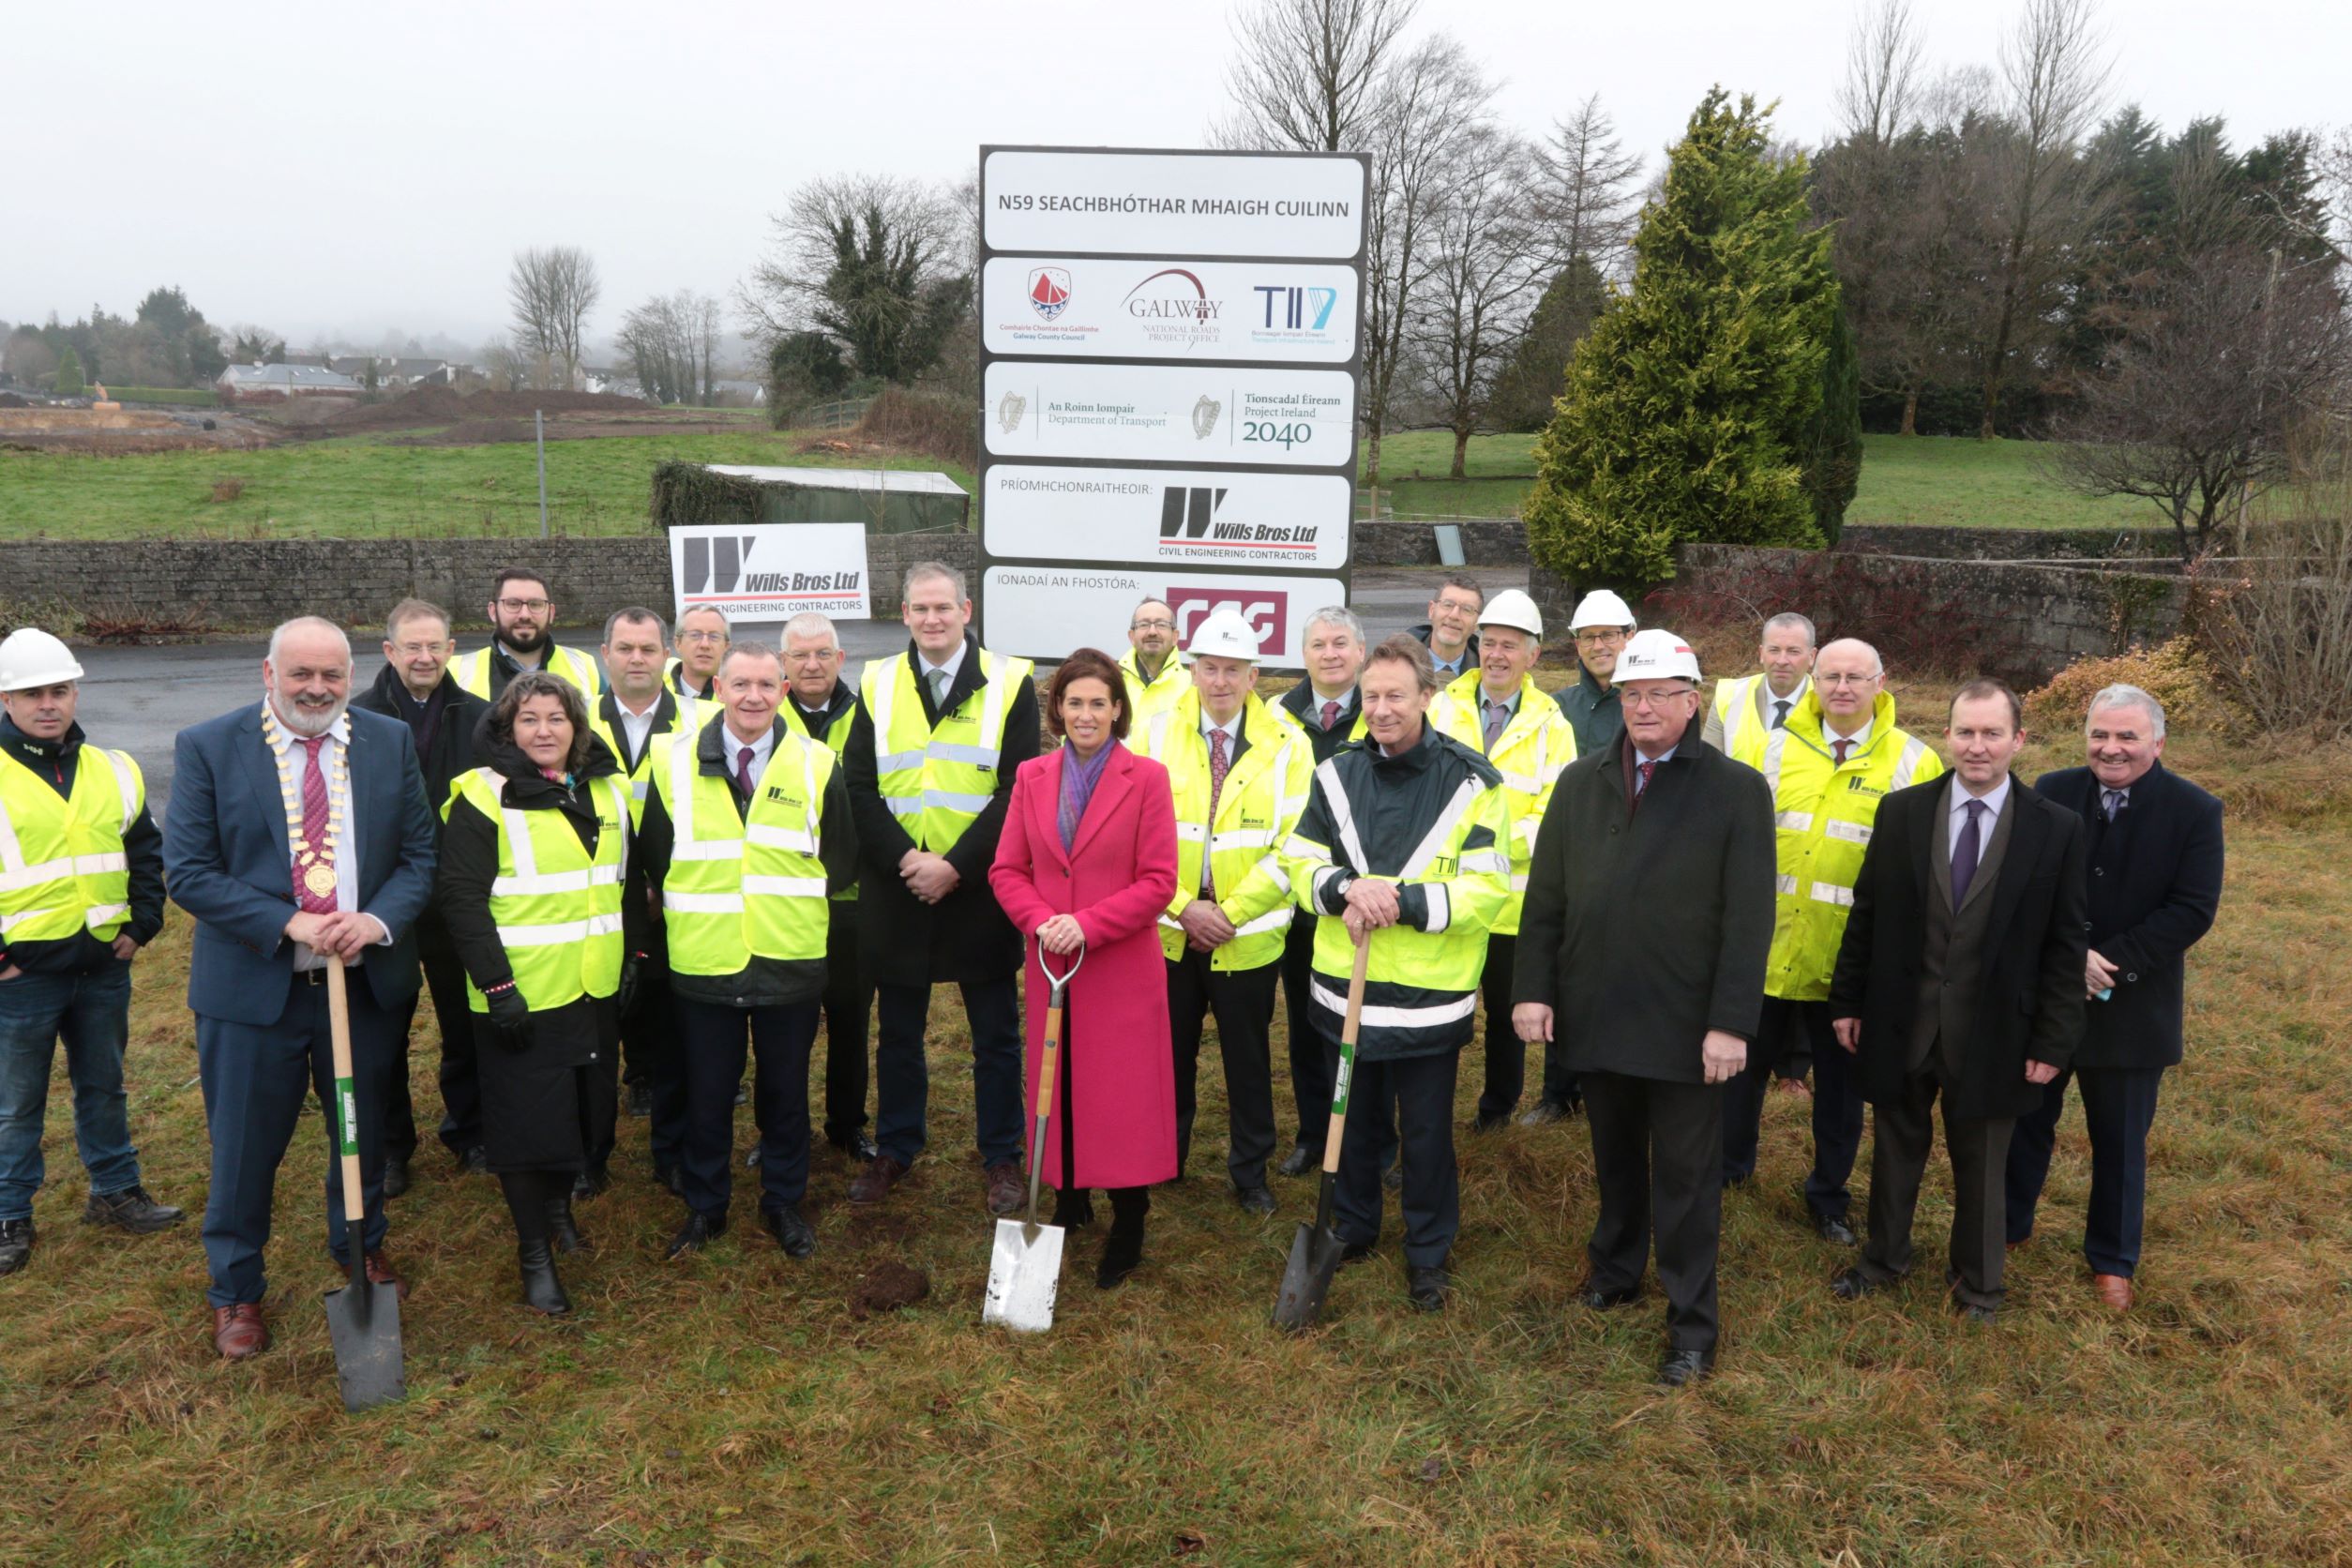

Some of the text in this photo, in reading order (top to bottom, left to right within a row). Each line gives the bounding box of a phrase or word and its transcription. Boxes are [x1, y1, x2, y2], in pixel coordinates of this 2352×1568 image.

[999, 193, 1349, 218] N59 SEACHBHÓTHAR MHAIGH CUILINN
[1013, 332, 1036, 340] Galway
[1142, 324, 1220, 334] NATIONAL ROADS
[1149, 333, 1187, 342] PROJECT
[1244, 393, 1341, 405] Tionscadal Éireann
[1048, 402, 1136, 415] An Roinn Iompair
[1244, 406, 1317, 418] Project Ireland
[1048, 414, 1167, 428] Department of Transport
[1242, 421, 1312, 450] 2040
[1001, 477, 1153, 494] PRÍOMHCHONRAITHEOIR:
[1213, 522, 1319, 542] Wills Bros Ltd
[1158, 547, 1317, 561] CIVIL ENGINEERING CONTRACTORS
[745, 571, 860, 593] Wills Bros Ltd
[997, 573, 1140, 590] IONADAÍ AN FHOSTÓRA:
[788, 600, 863, 611] CONTRACTORS
